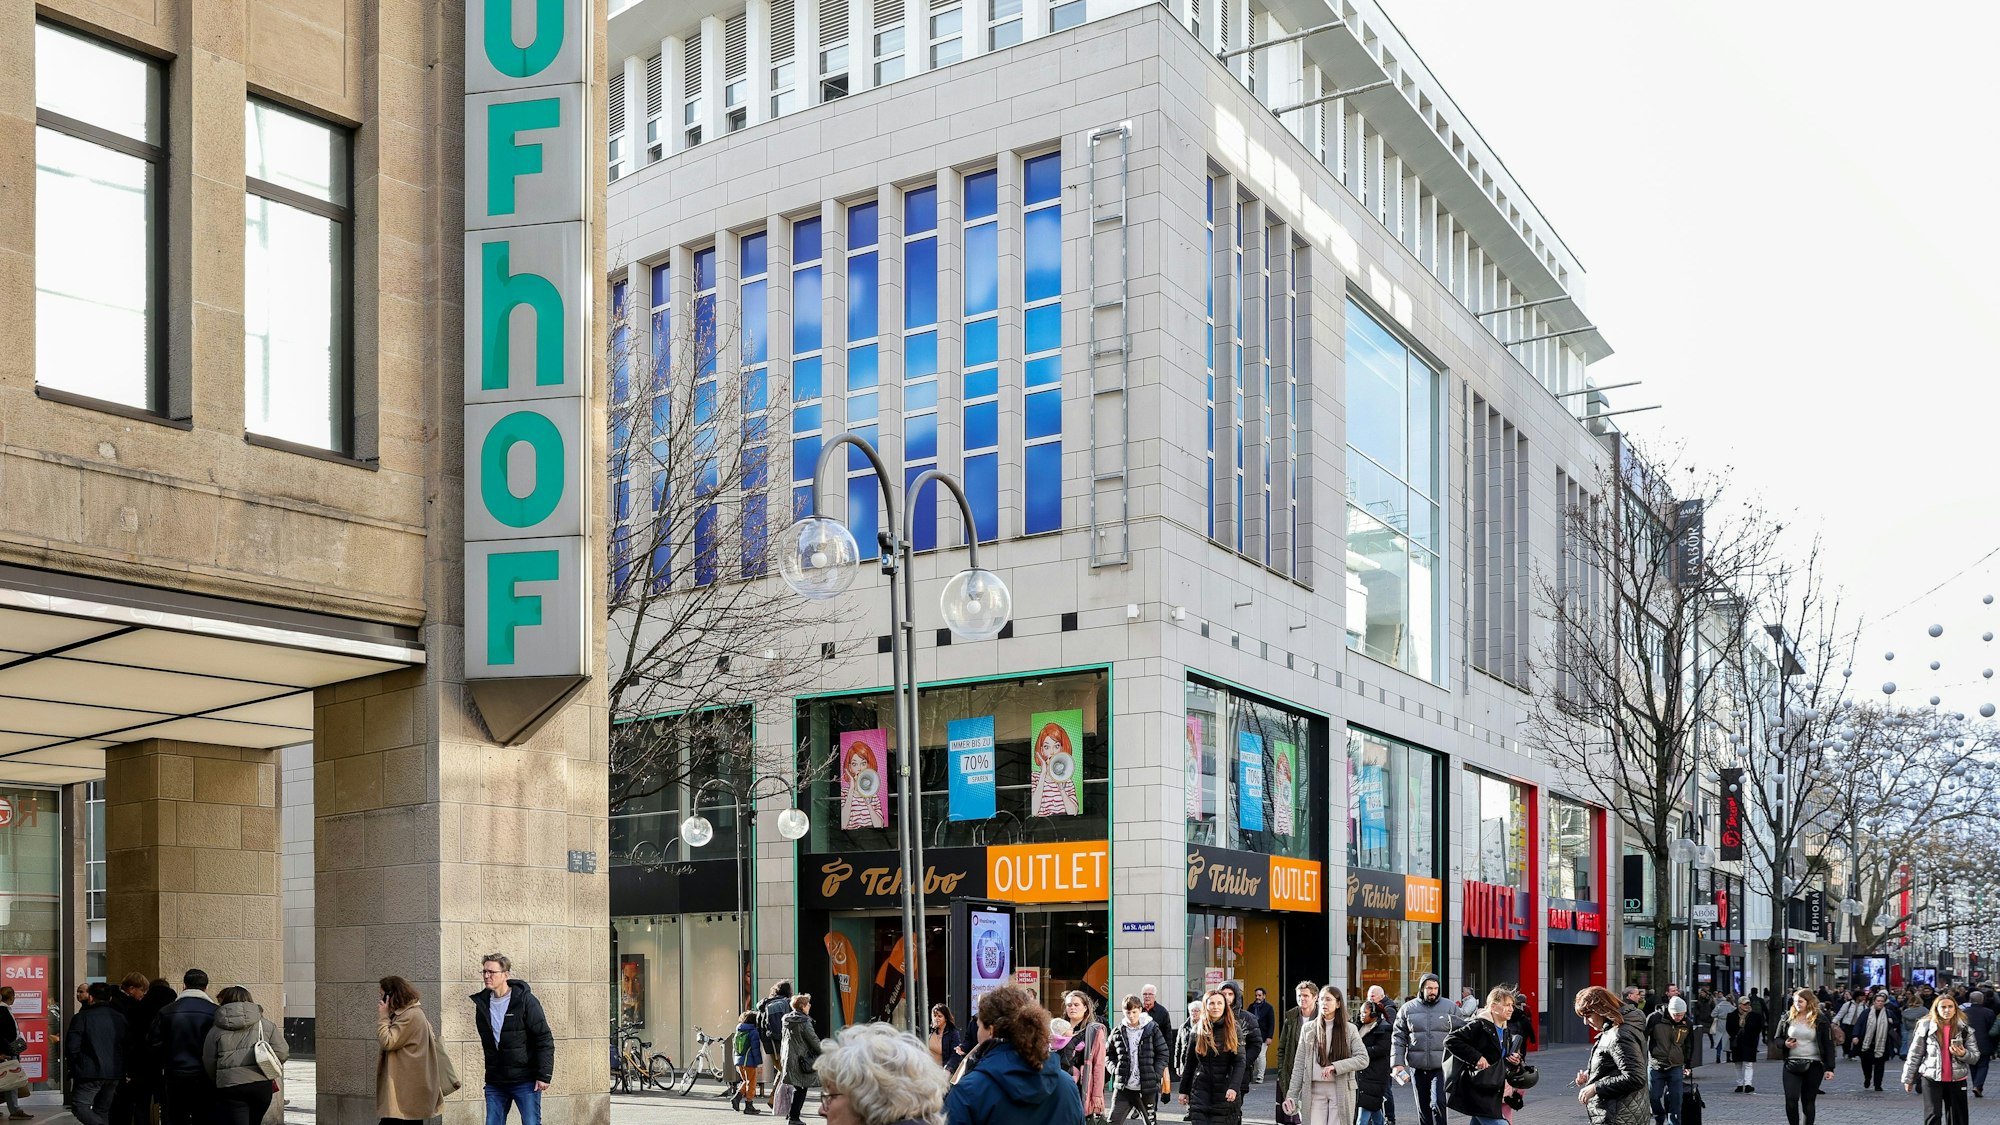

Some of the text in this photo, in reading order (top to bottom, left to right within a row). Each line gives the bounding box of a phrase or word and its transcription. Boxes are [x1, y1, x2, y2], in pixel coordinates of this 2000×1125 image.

[951, 737, 991, 750] IMMER BIS ZU
[963, 755, 989, 770] 70%
[994, 851, 1106, 892] OUTLET
[1208, 863, 1318, 902] Tchibo OUTLET
[1361, 883, 1440, 914] Tchibo OUTLET
[1693, 908, 1716, 918] ABOR
[5, 967, 44, 979] SALE
[20, 1031, 44, 1043] ALE
